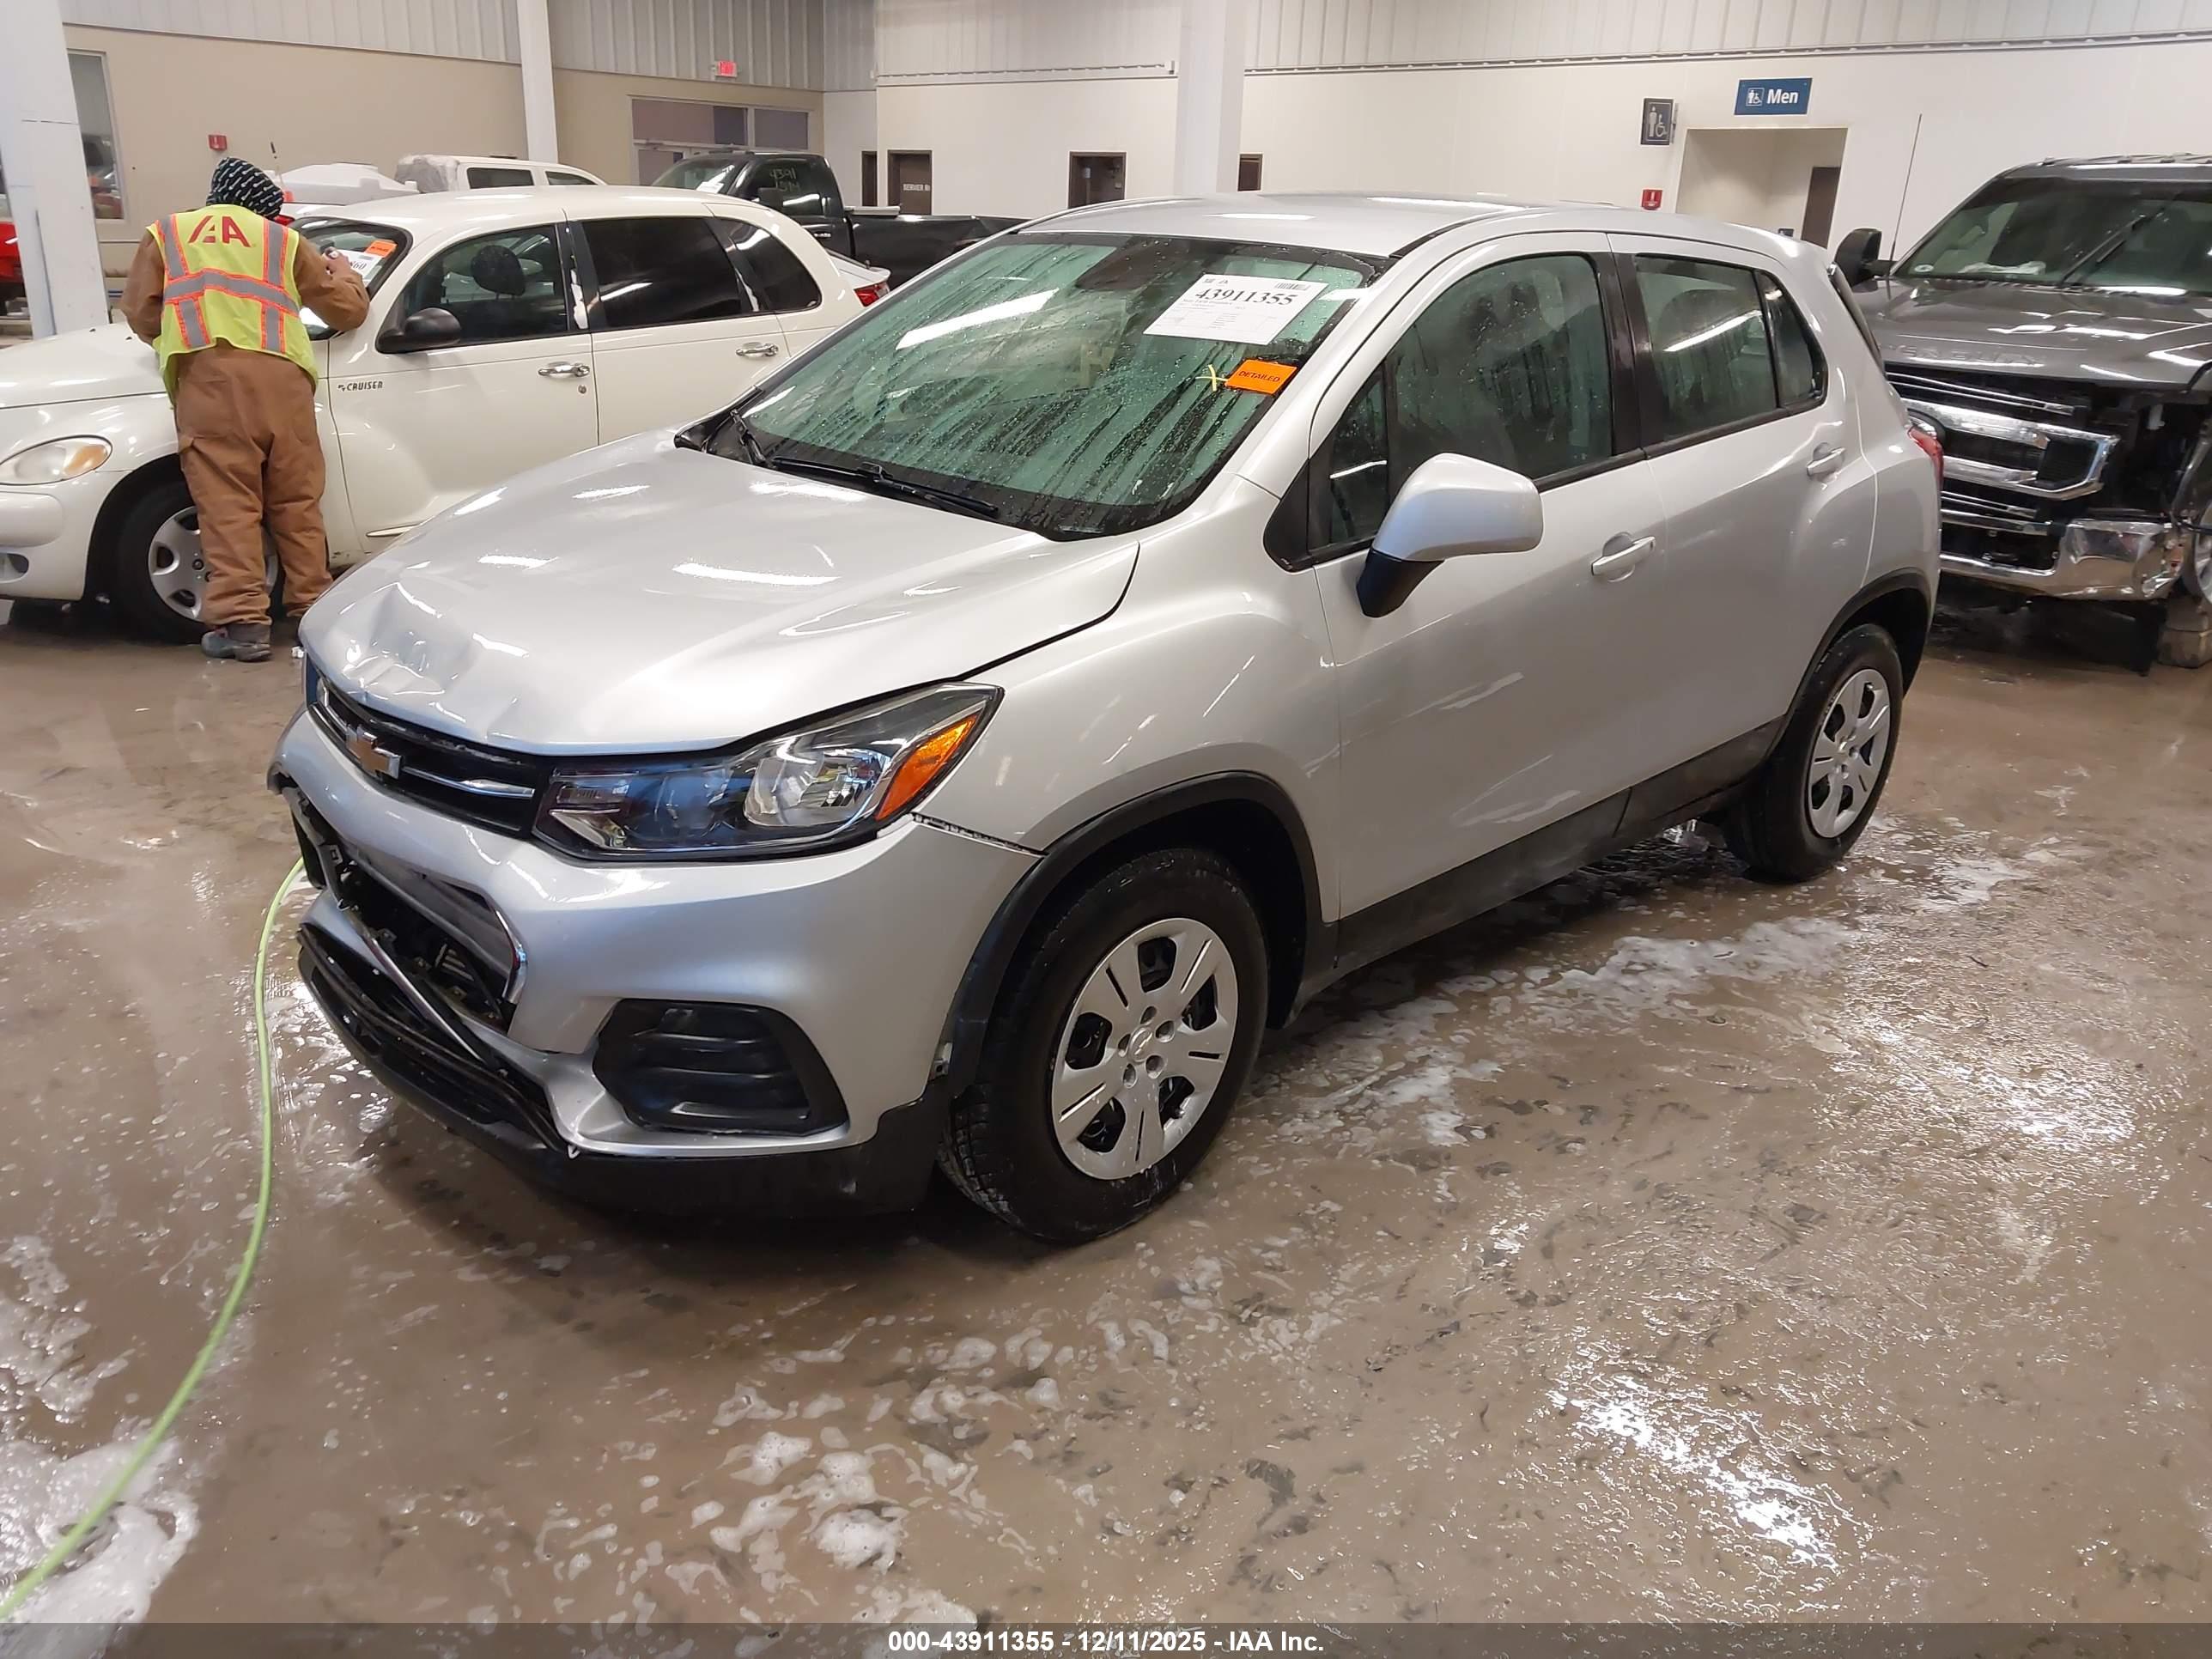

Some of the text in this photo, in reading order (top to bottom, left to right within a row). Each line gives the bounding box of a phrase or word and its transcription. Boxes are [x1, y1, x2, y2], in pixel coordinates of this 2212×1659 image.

[1766, 88, 1799, 104] Men
[1195, 288, 1299, 306] 43911355
[1238, 370, 1281, 383] DETAILED
[346, 380, 383, 392] CRUISER
